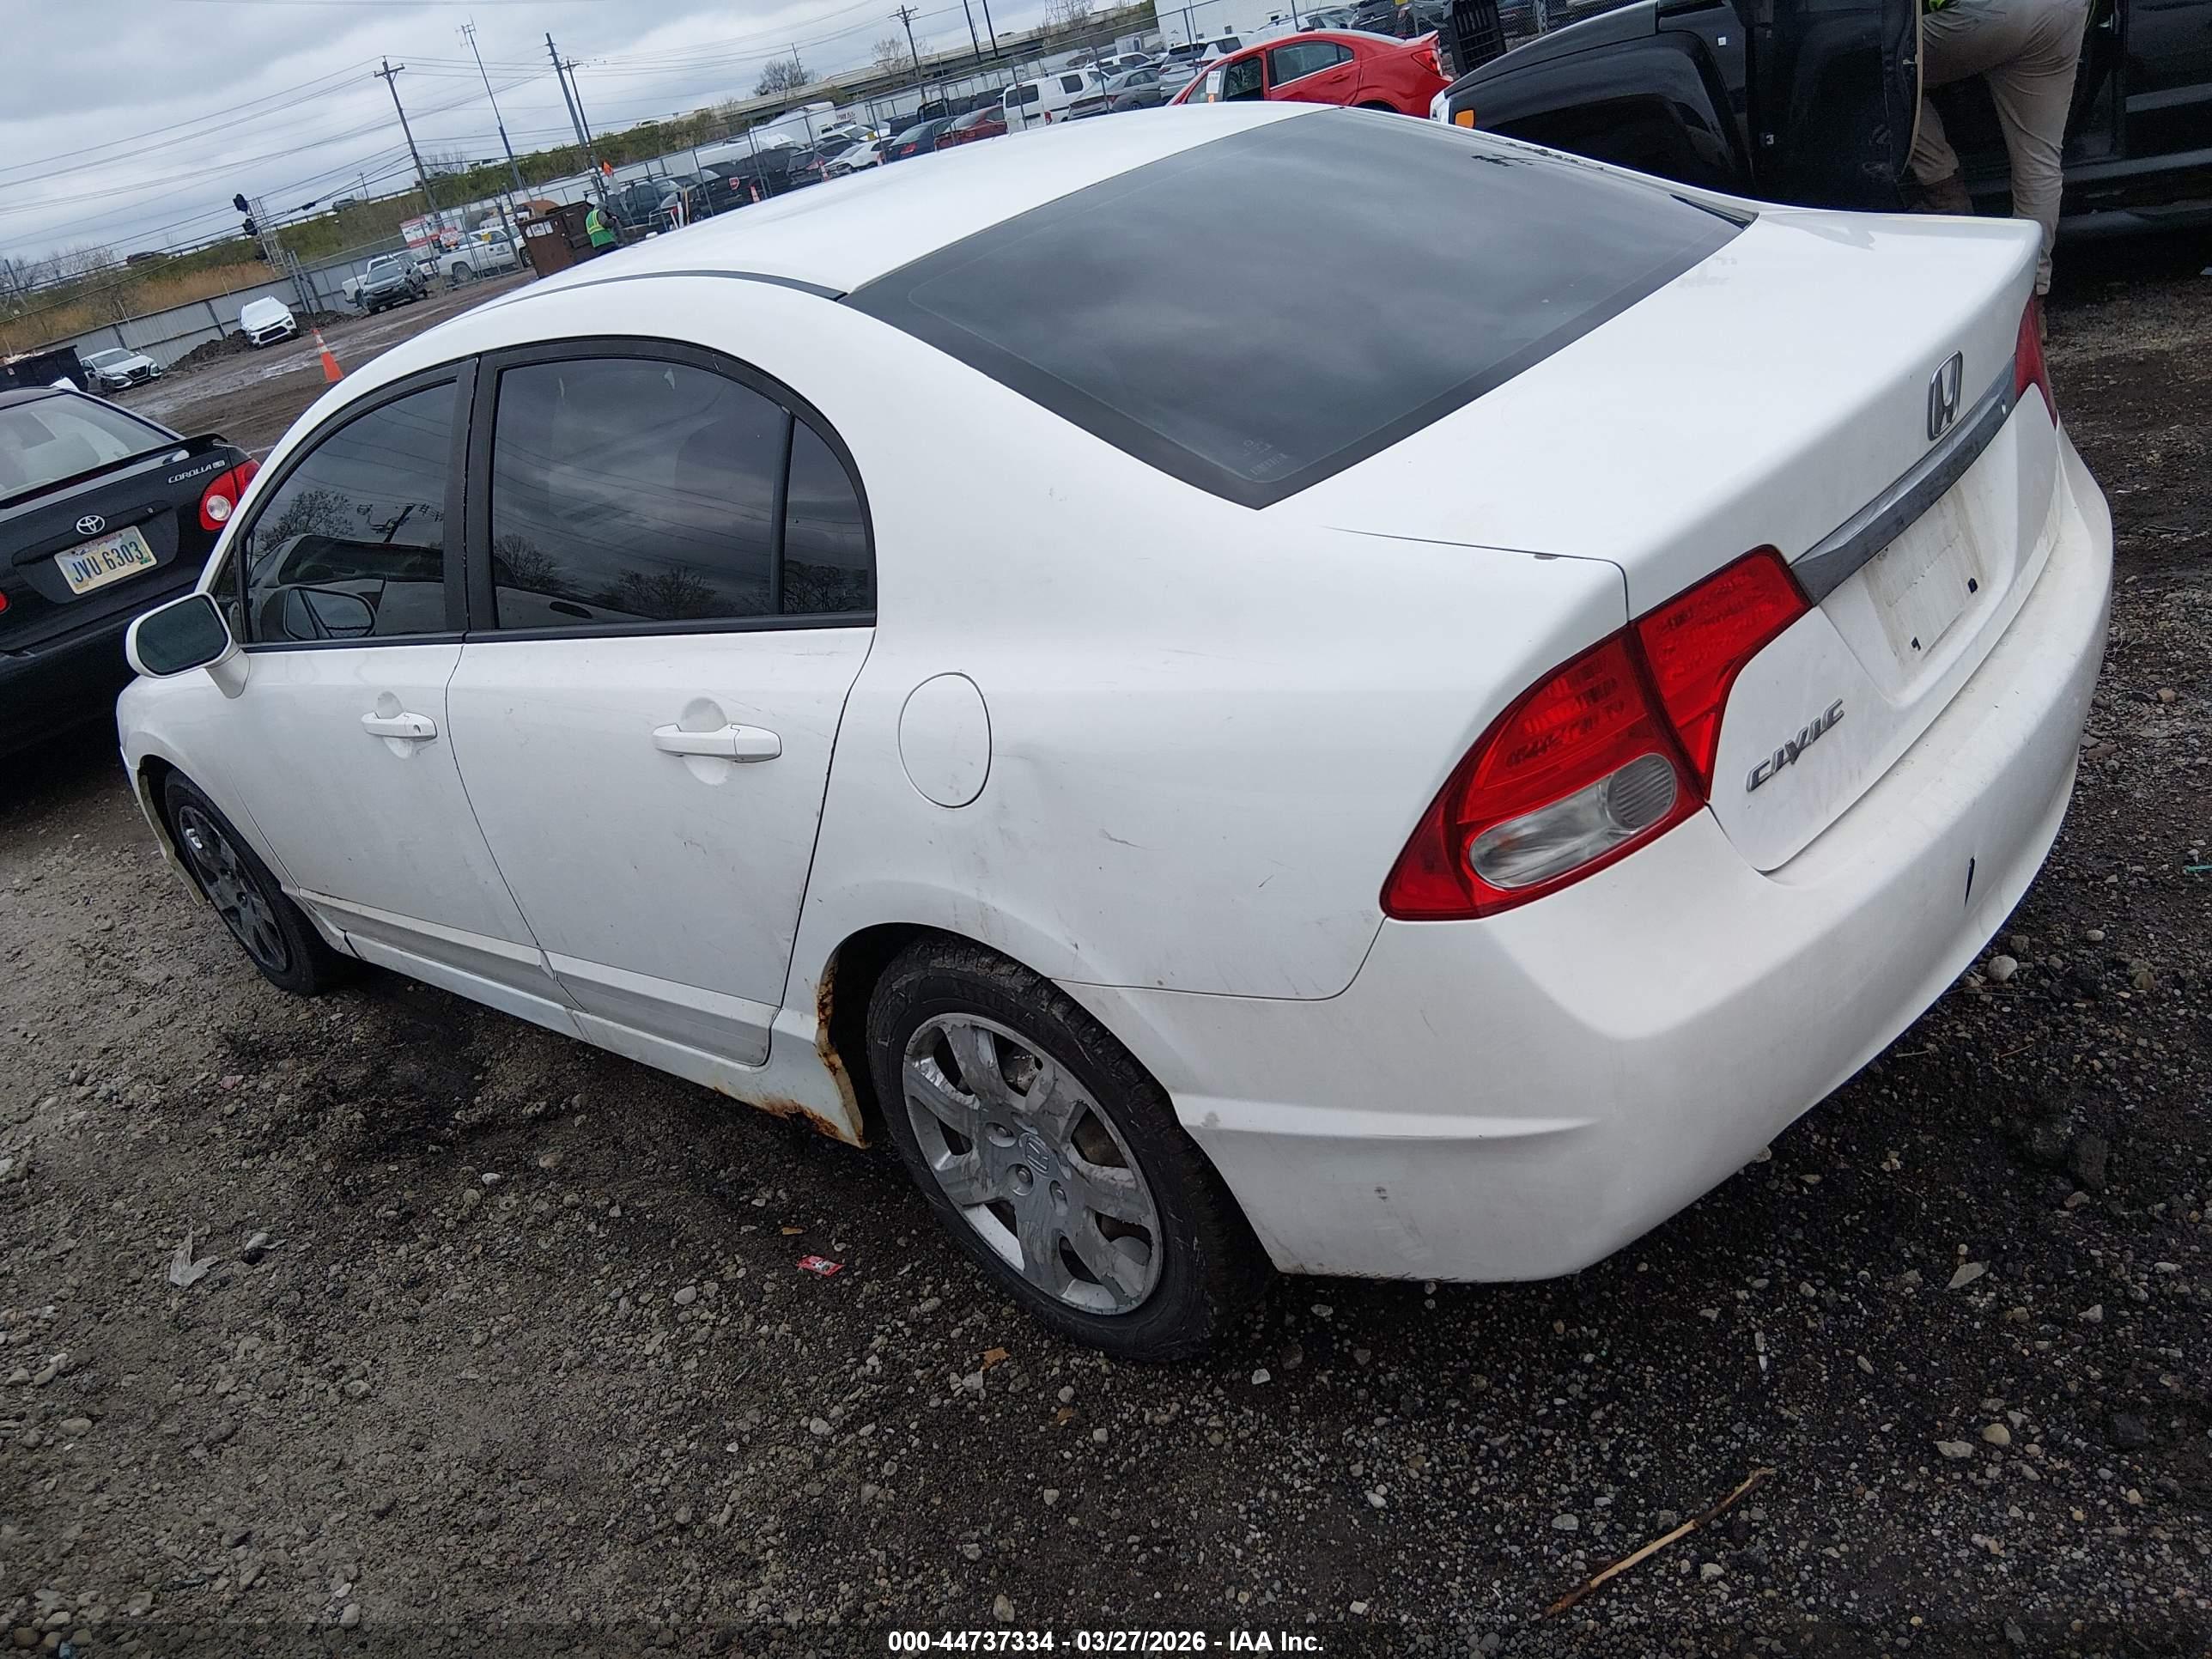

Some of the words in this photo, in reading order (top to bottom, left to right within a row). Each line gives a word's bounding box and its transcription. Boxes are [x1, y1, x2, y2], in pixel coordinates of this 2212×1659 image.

[168, 464, 212, 483] COROLLA
[72, 556, 103, 583] JVU
[102, 541, 144, 570] 6303
[1746, 698, 1844, 793] CIVIC
